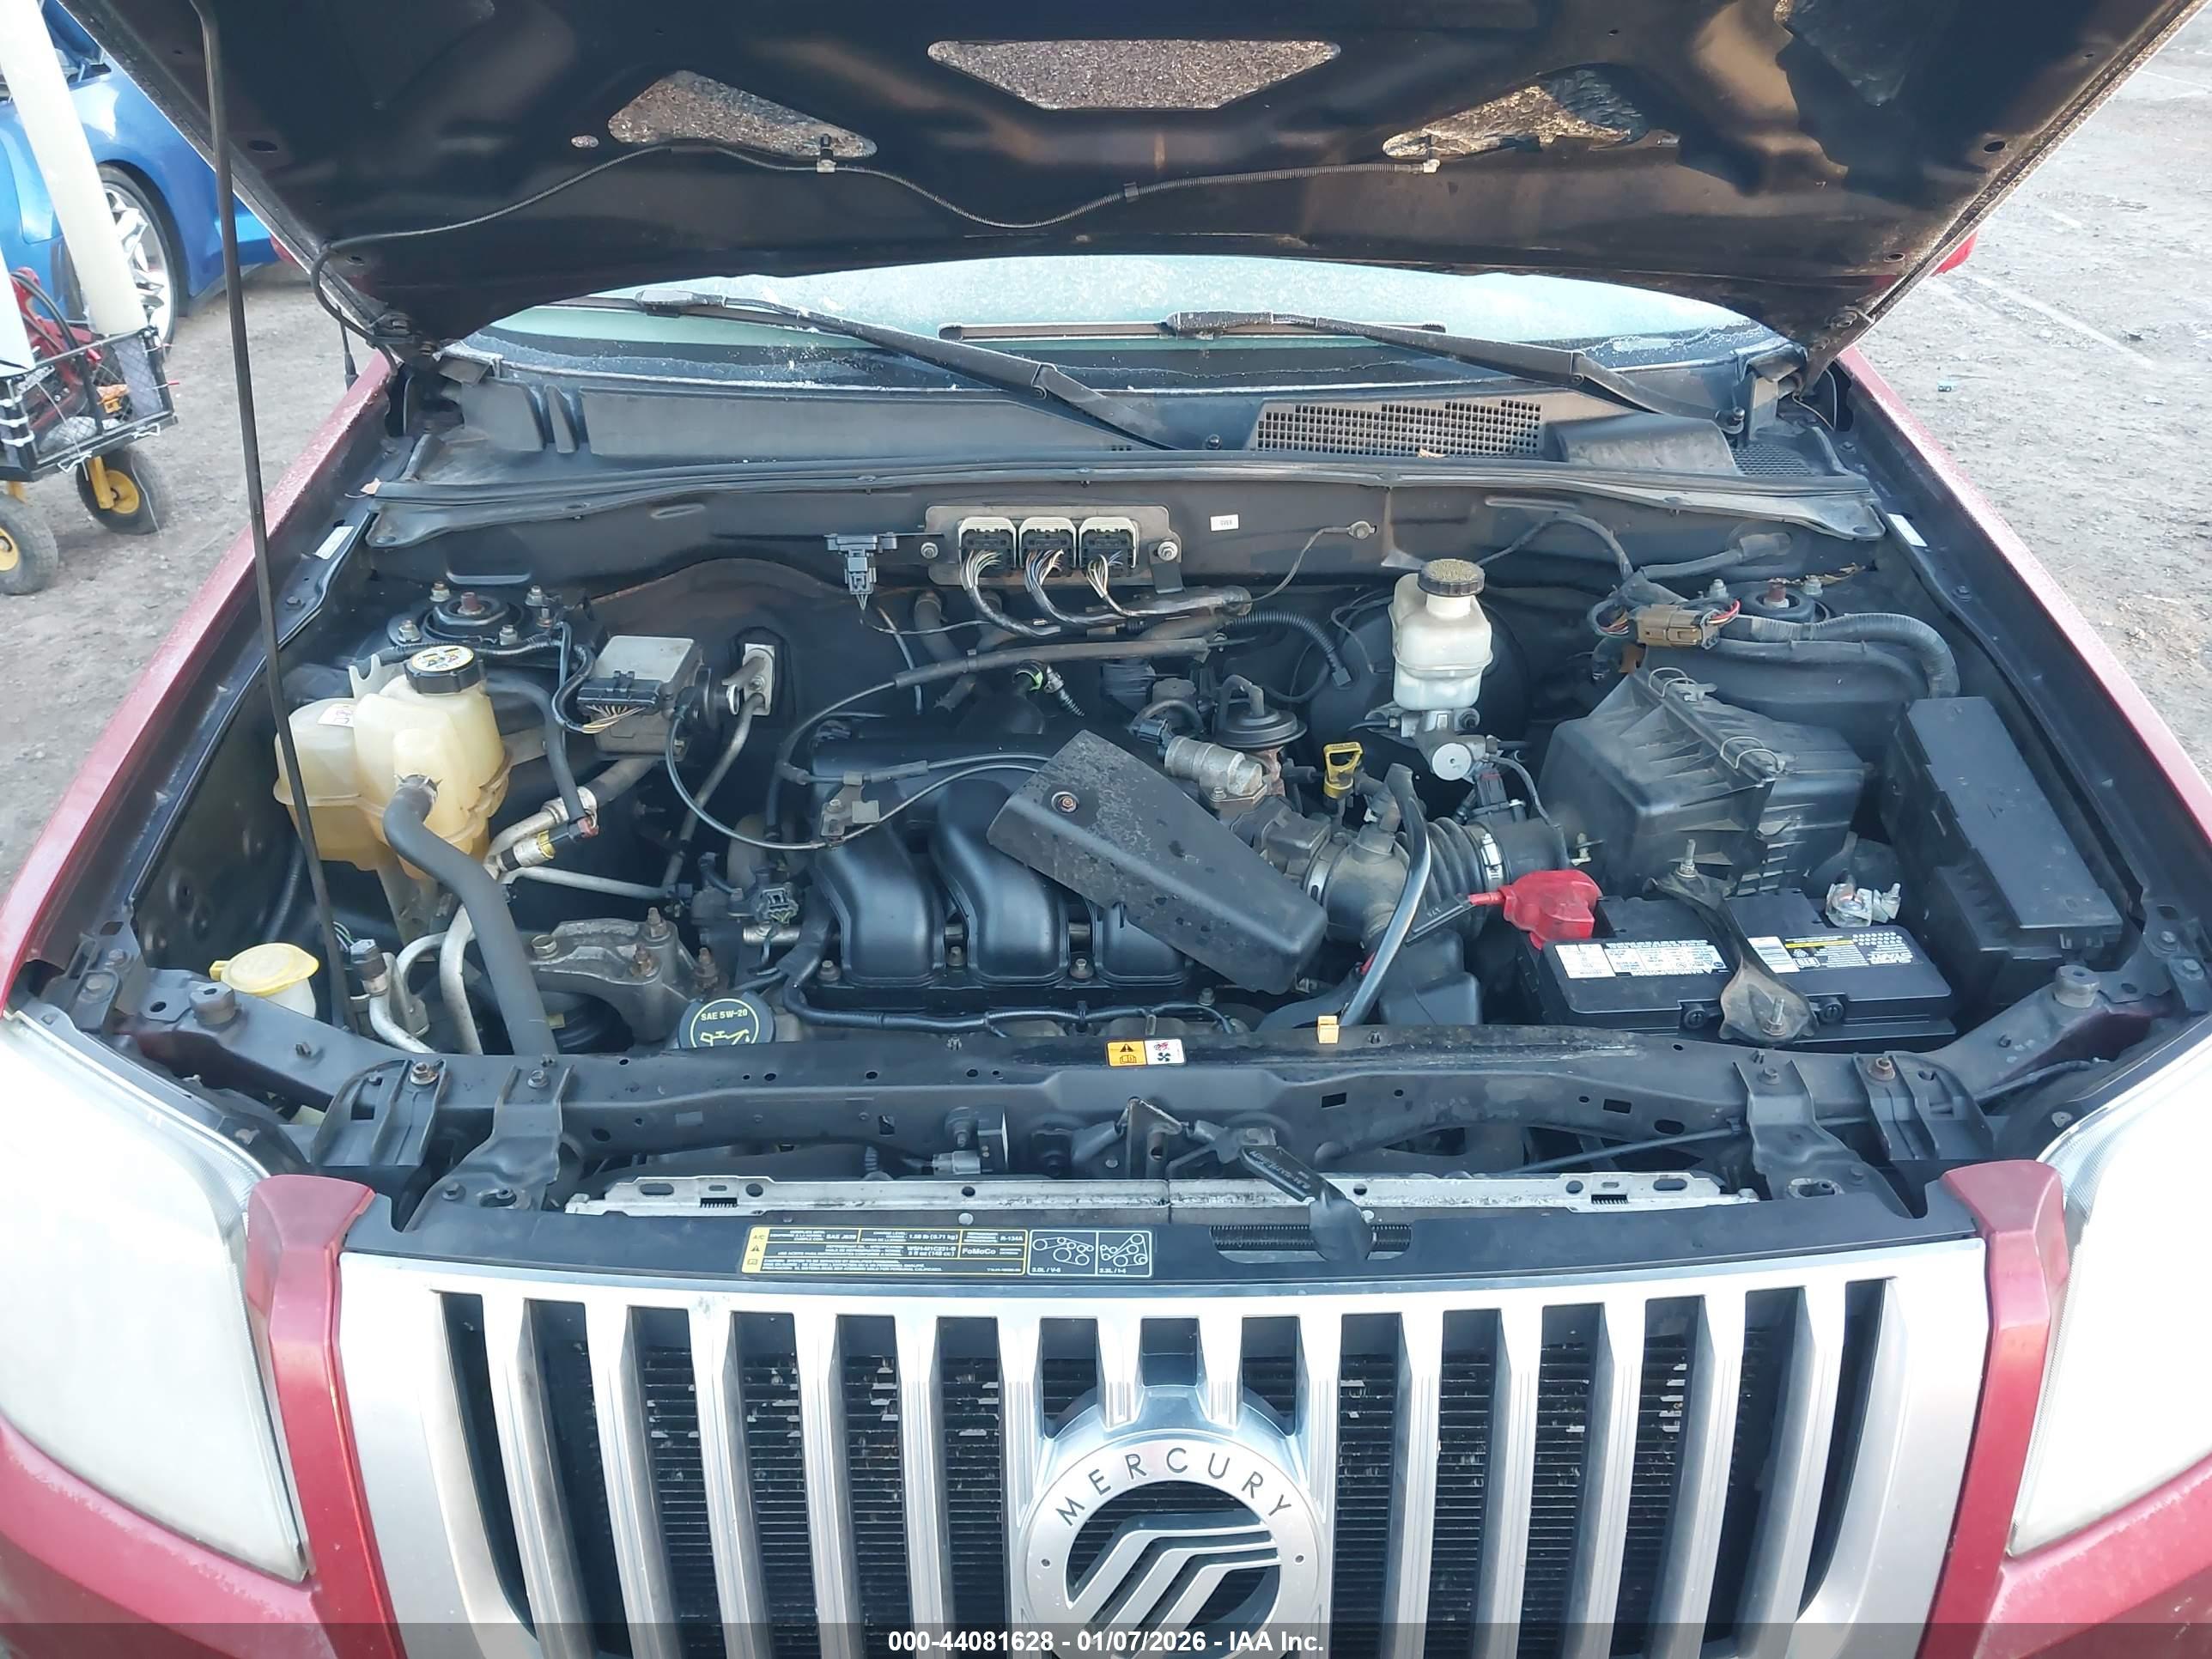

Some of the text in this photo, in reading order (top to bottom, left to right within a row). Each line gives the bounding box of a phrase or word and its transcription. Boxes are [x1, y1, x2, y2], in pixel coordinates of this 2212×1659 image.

[701, 1008, 748, 1021] SAE 5W-20
[1055, 1448, 1291, 1526] MERCURY
